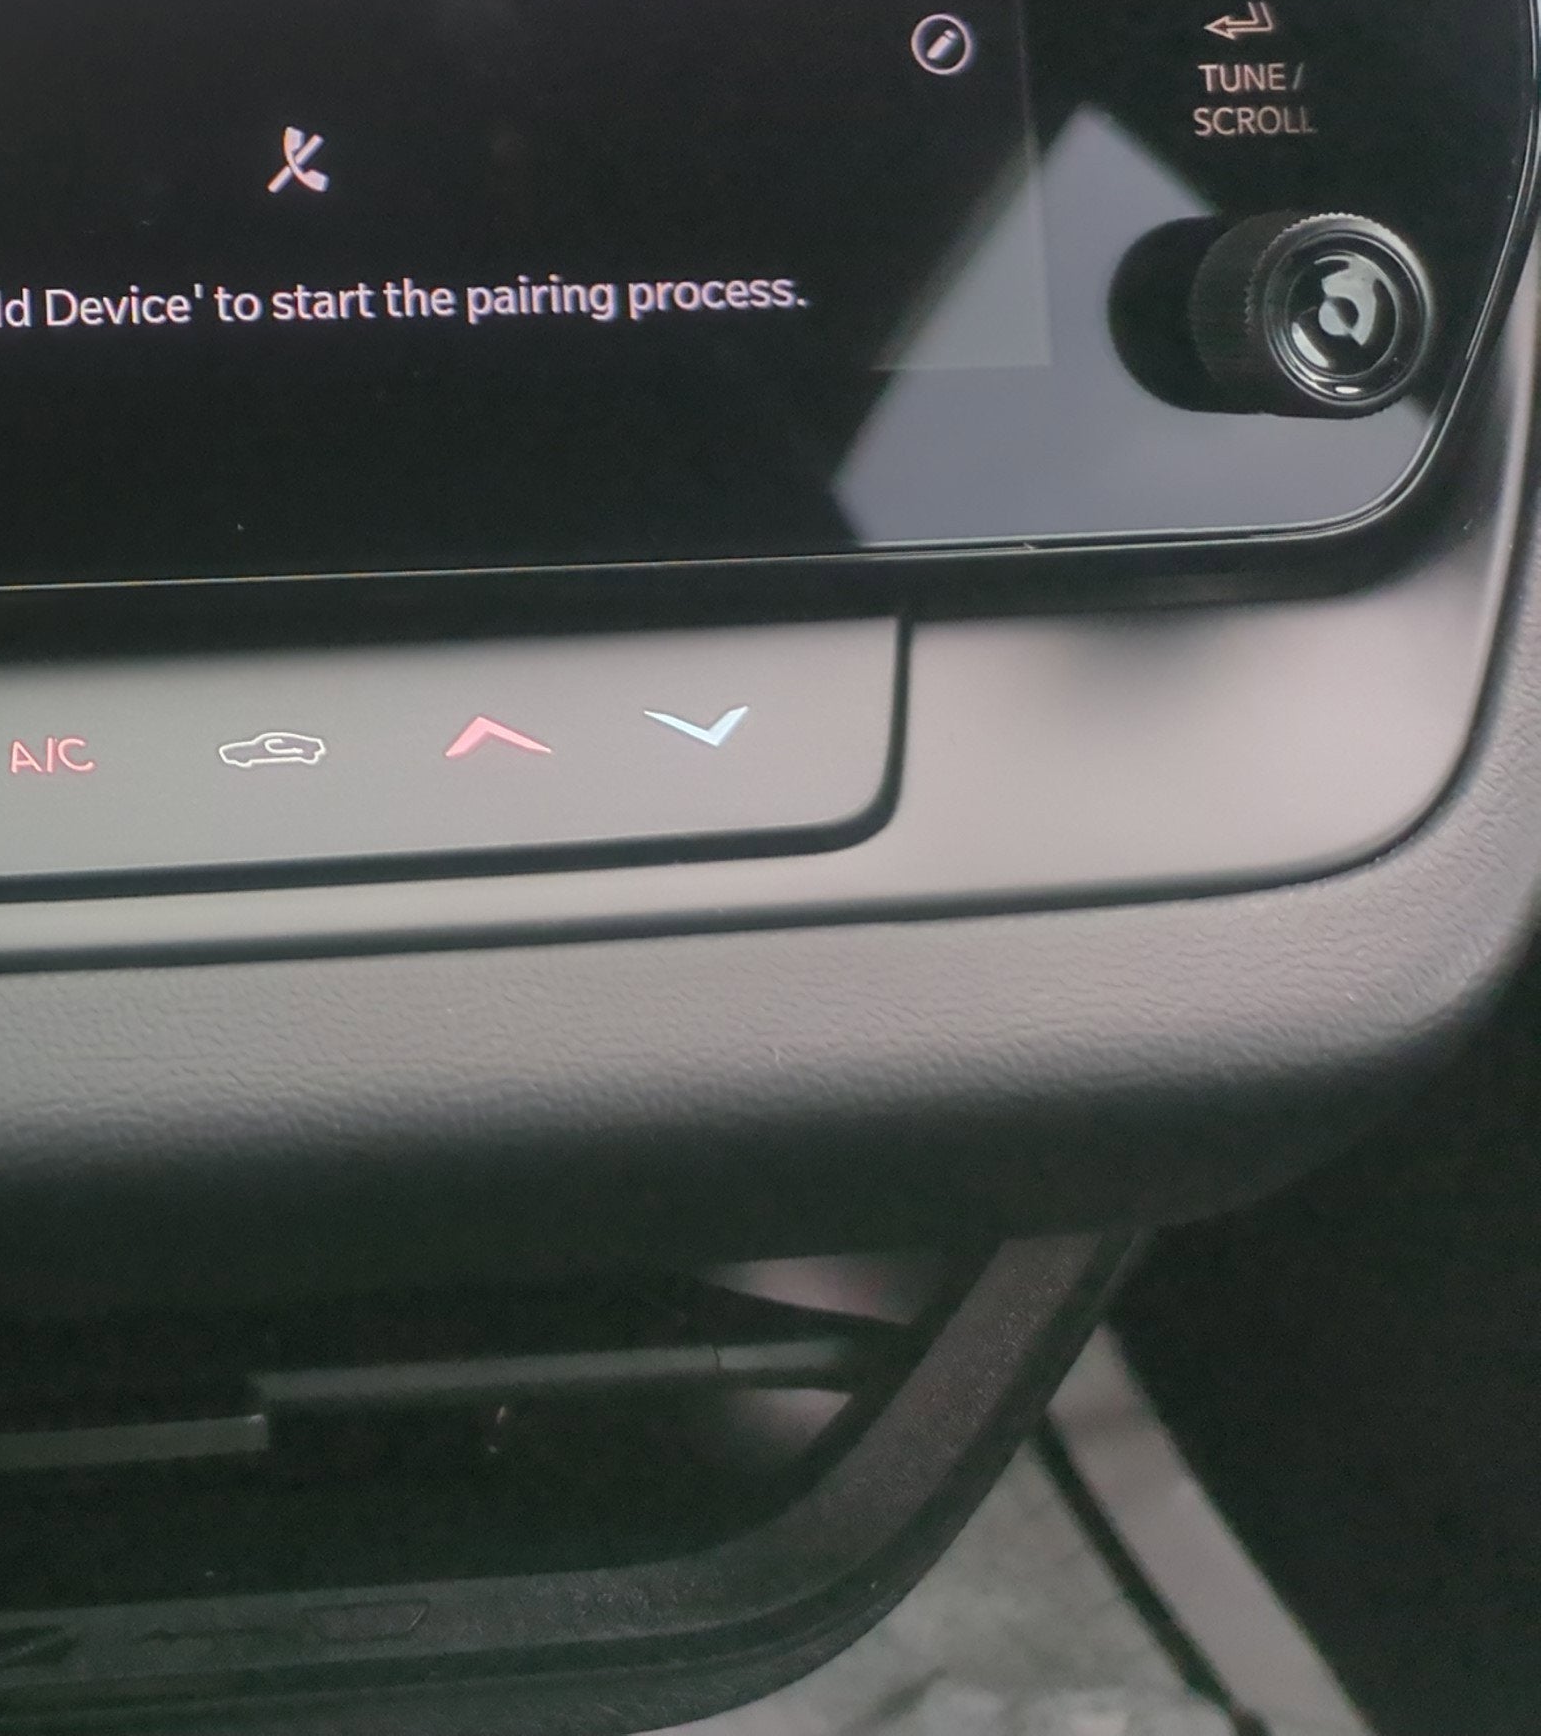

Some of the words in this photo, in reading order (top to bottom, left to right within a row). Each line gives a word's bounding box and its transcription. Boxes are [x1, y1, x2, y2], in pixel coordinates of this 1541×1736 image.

[1192, 105, 1317, 138] SCROLL
[44, 283, 204, 328] Device'
[215, 284, 263, 322] to
[271, 282, 374, 321] start
[382, 277, 457, 318] the
[465, 275, 615, 324] pairing
[627, 277, 809, 321] process.
[8, 737, 96, 777] A/C
